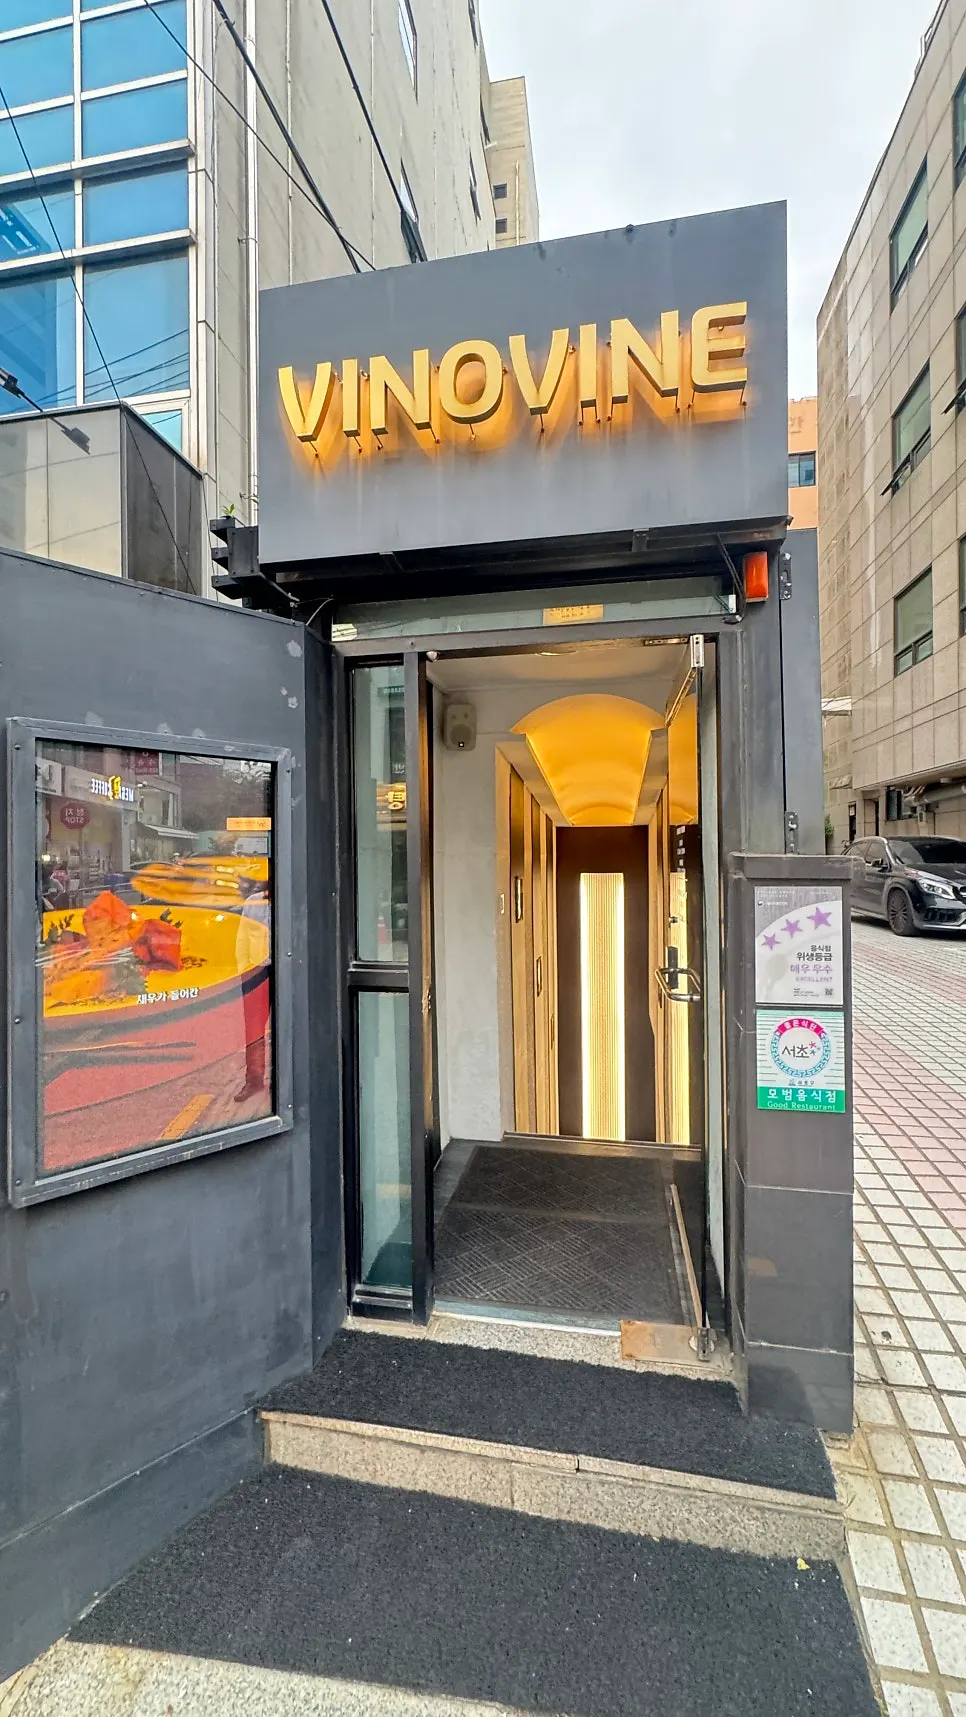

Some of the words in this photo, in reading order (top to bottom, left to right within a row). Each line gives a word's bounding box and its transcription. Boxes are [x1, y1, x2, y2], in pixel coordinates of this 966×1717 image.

[277, 301, 748, 442] VINOVINE
[796, 952, 833, 962] 위생등급
[790, 963, 811, 975] 매우
[812, 963, 833, 975] 우수
[137, 991, 167, 1005] 새우가
[170, 988, 199, 1001] 들어간
[781, 1044, 810, 1058] 서초
[767, 1088, 836, 1104] 모범음식점
[767, 1100, 789, 1109] Good
[791, 1101, 836, 1112] Restaurant
